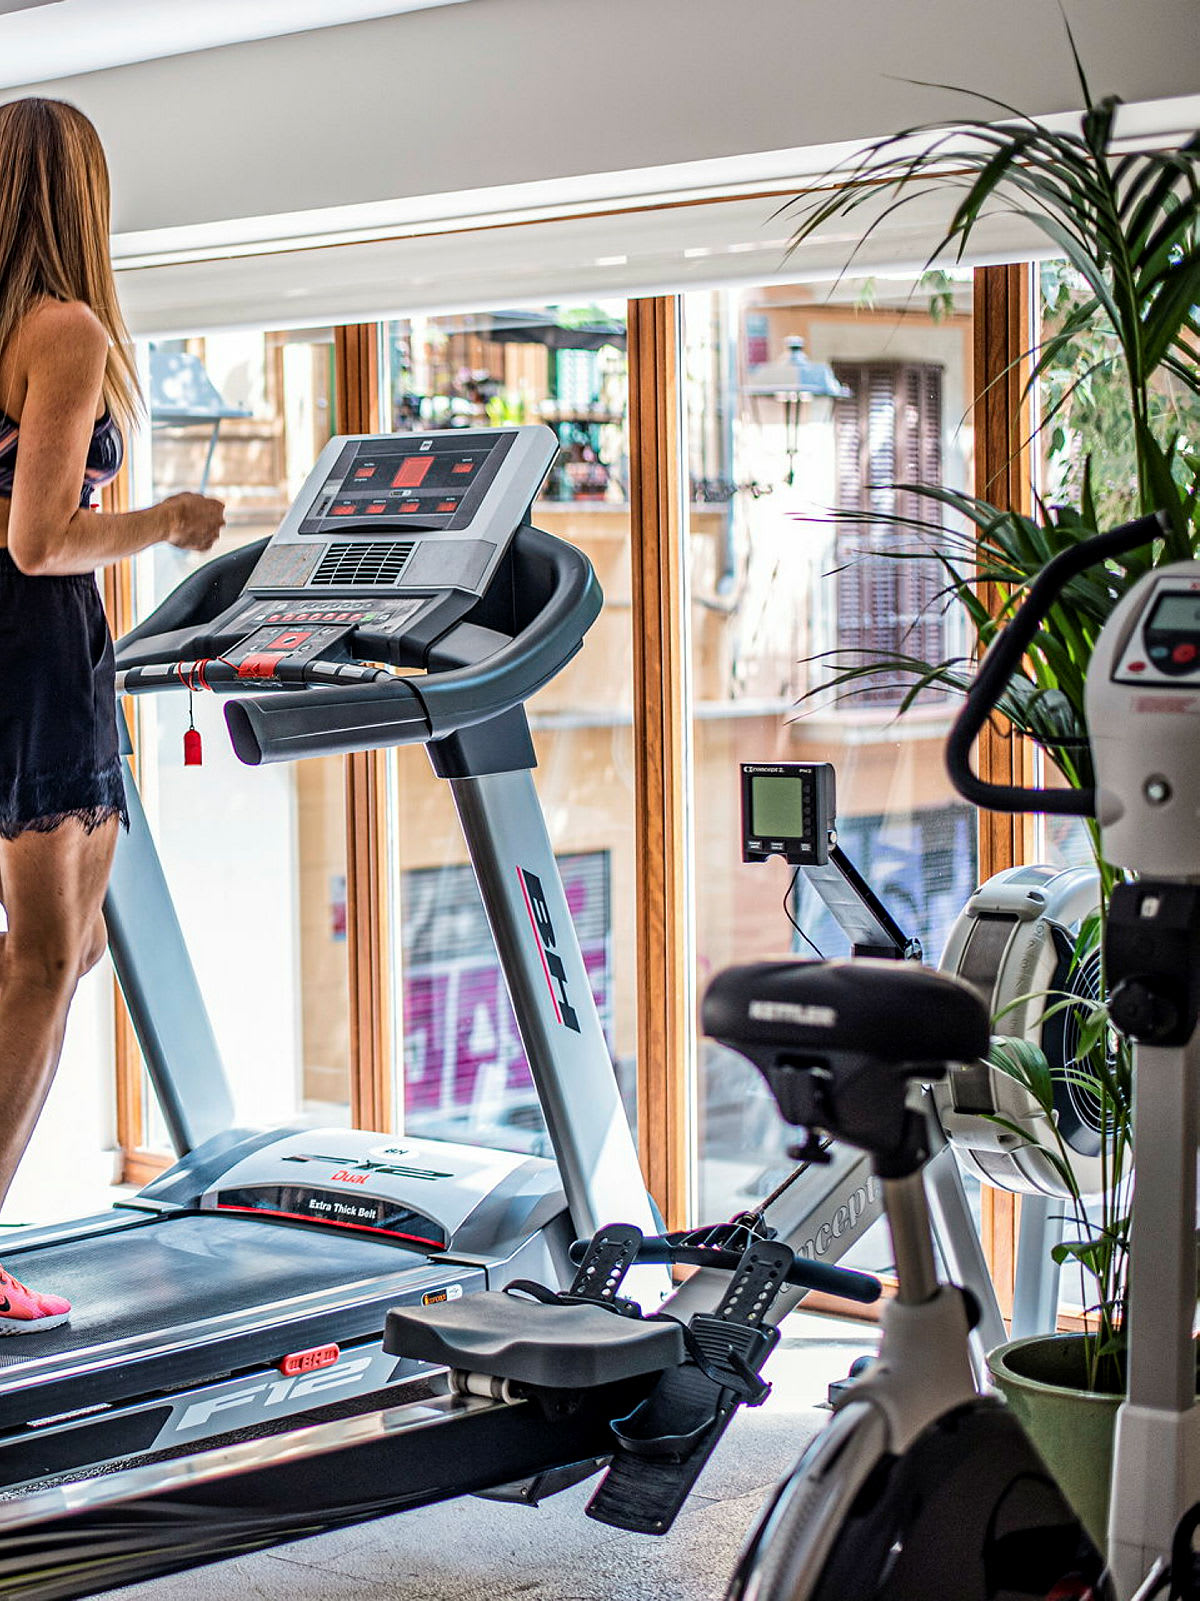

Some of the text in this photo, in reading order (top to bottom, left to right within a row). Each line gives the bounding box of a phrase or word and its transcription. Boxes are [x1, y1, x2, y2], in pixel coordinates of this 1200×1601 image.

[522, 868, 582, 1034] BH
[749, 1000, 837, 1028] KETTLER
[330, 1169, 371, 1185] Dual
[308, 1198, 377, 1220] Extra Thick Belt
[175, 1356, 373, 1432] F12
